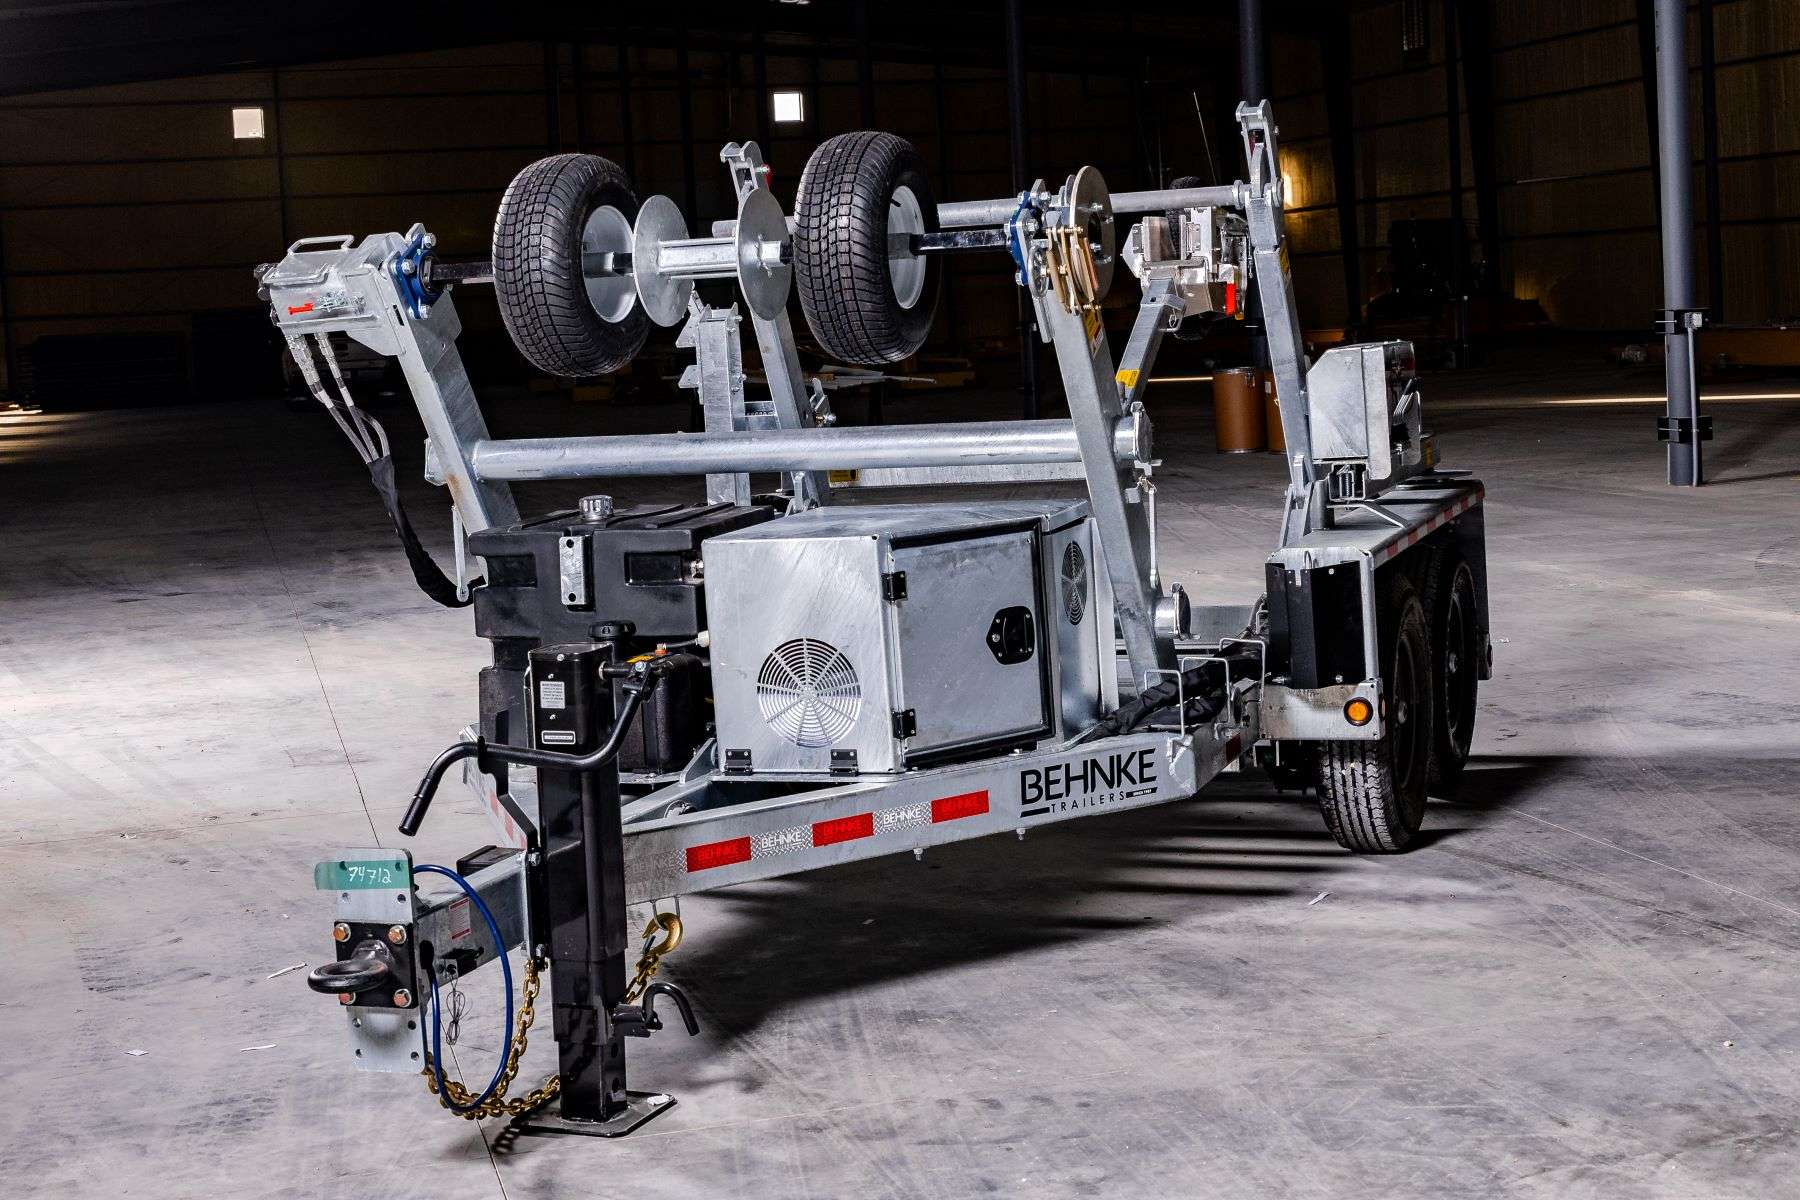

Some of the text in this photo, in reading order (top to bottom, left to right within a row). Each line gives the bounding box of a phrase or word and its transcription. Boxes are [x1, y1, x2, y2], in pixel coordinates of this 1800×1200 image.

[1020, 748, 1157, 805] BEHNKE
[1051, 791, 1124, 813] TRAILERS
[883, 808, 921, 824] BEHNKE
[761, 831, 802, 849] BEHNKE
[348, 866, 392, 885] 74712
